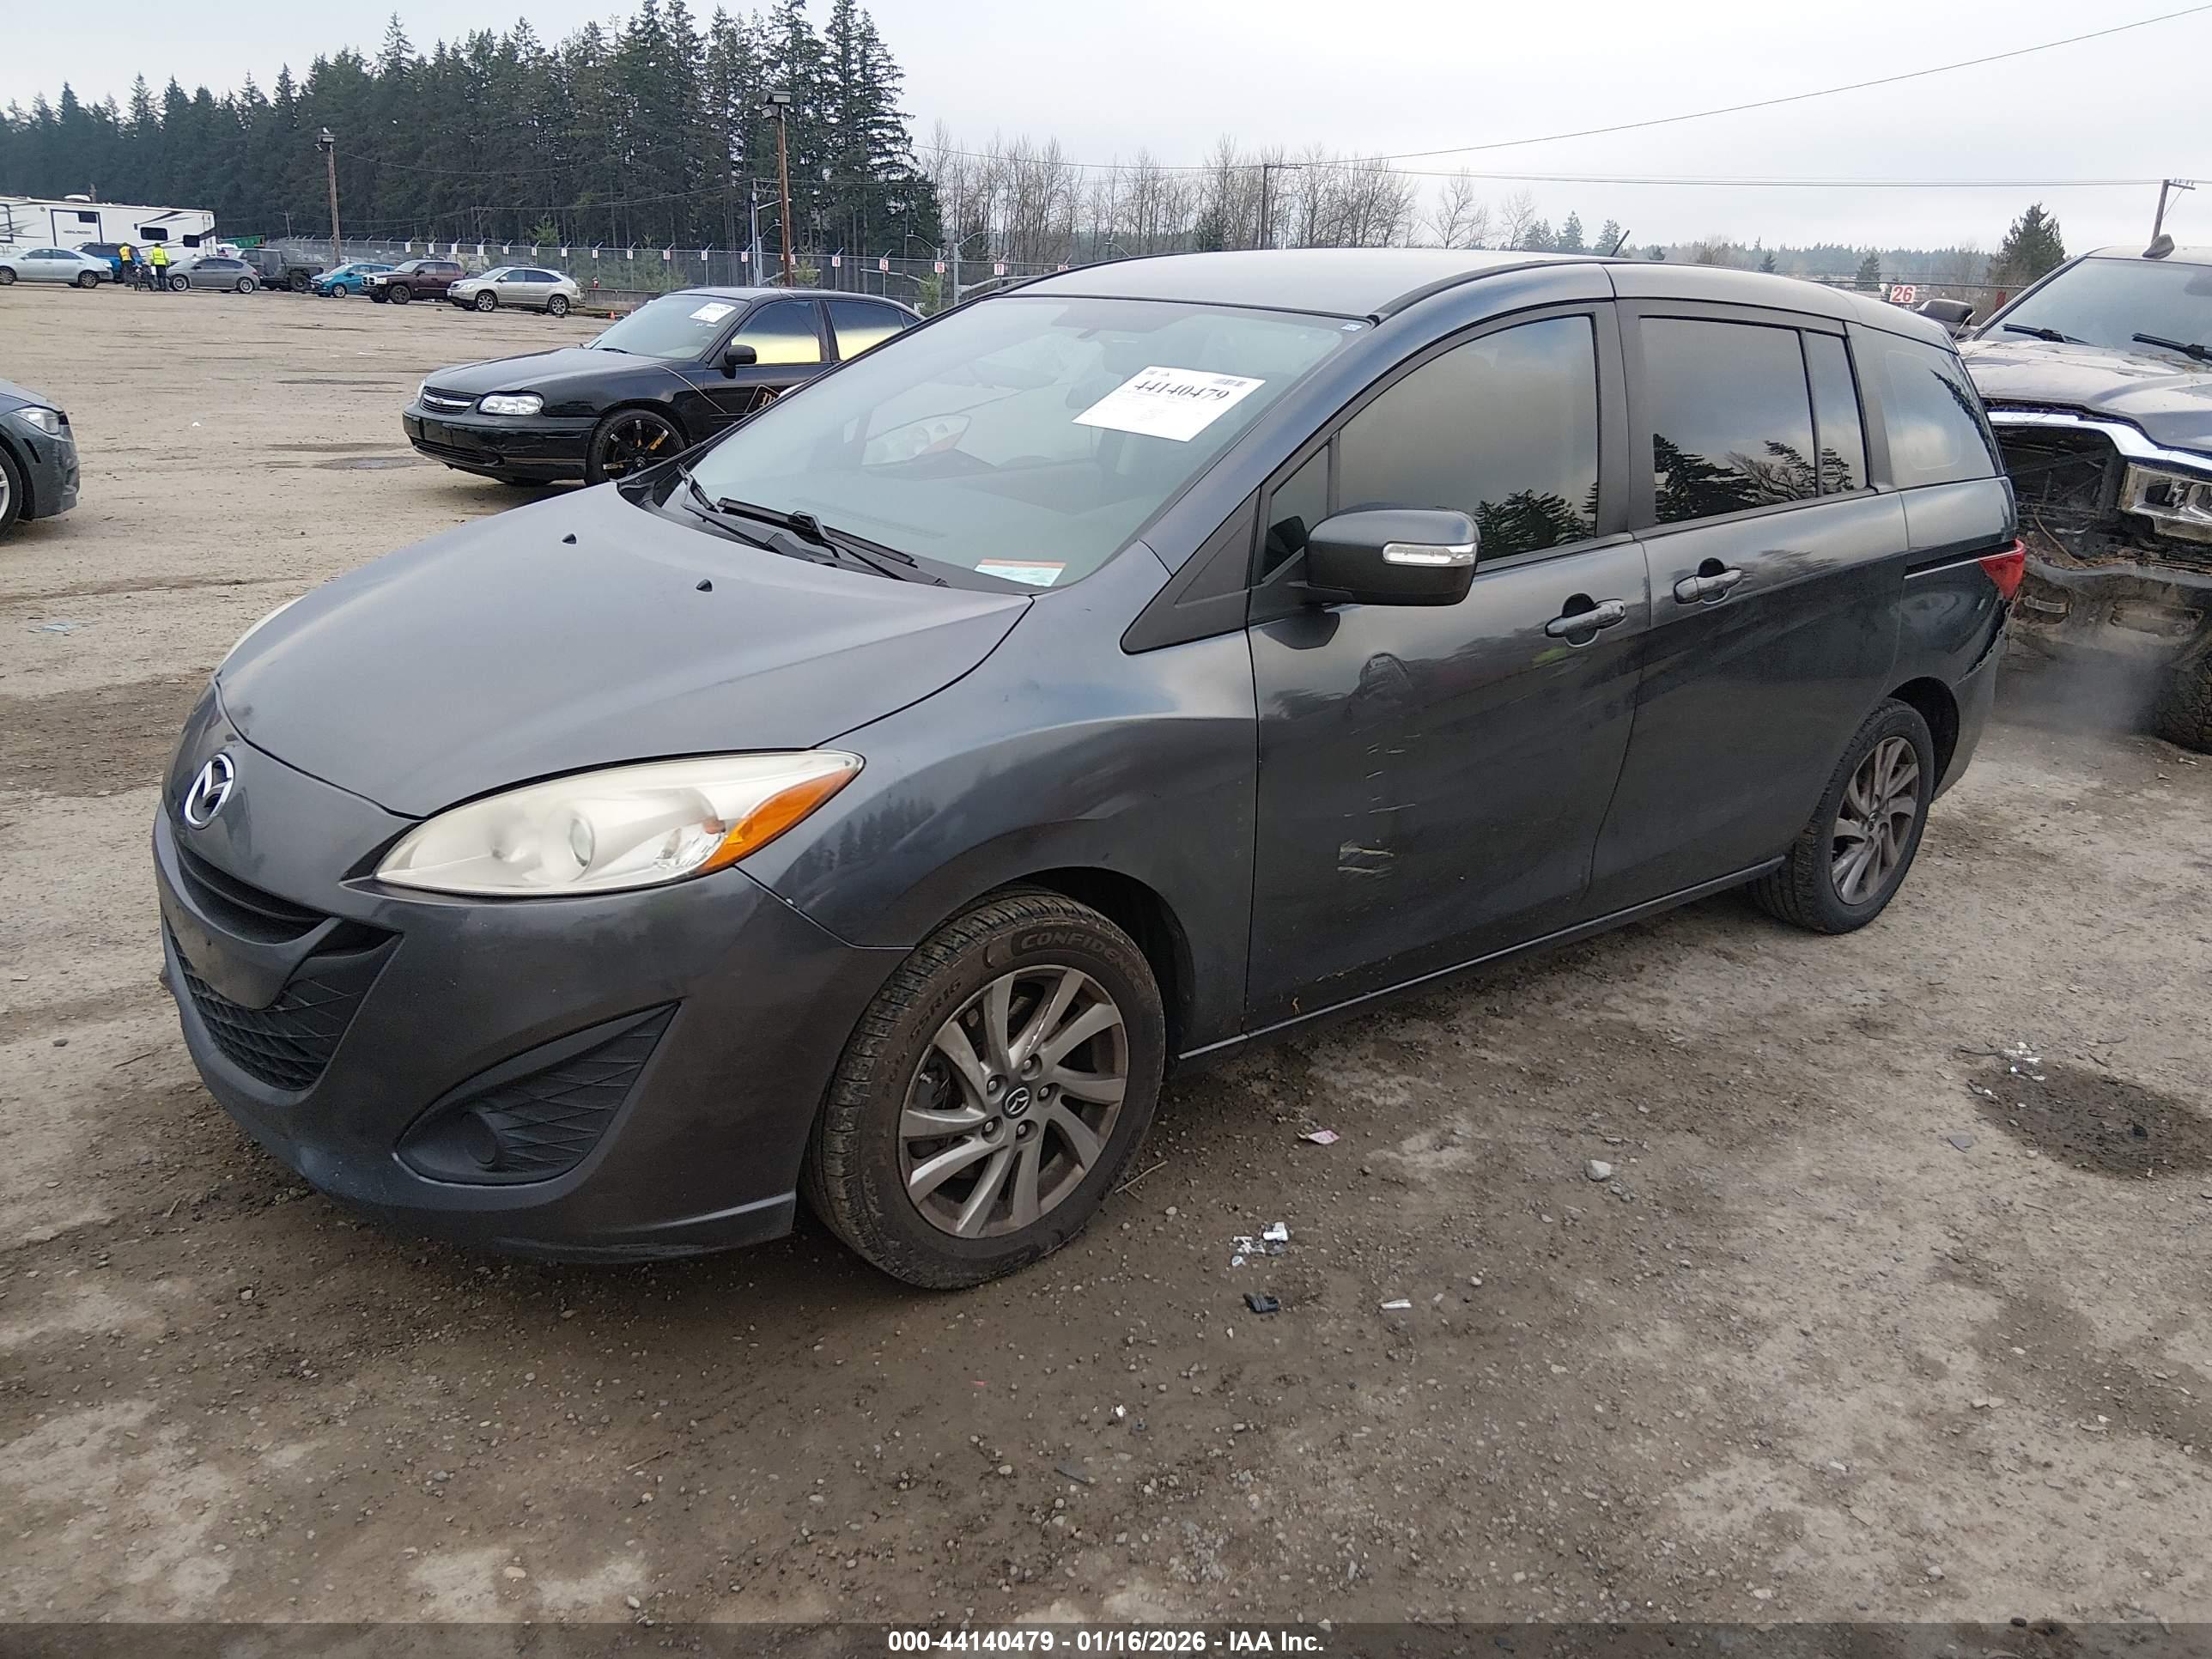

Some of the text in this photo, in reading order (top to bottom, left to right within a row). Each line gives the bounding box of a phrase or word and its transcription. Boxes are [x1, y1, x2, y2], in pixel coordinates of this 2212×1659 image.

[936, 263, 943, 272] 16
[996, 264, 1003, 274] 17
[1892, 286, 1913, 302] 26
[1134, 380, 1230, 401] 44140479
